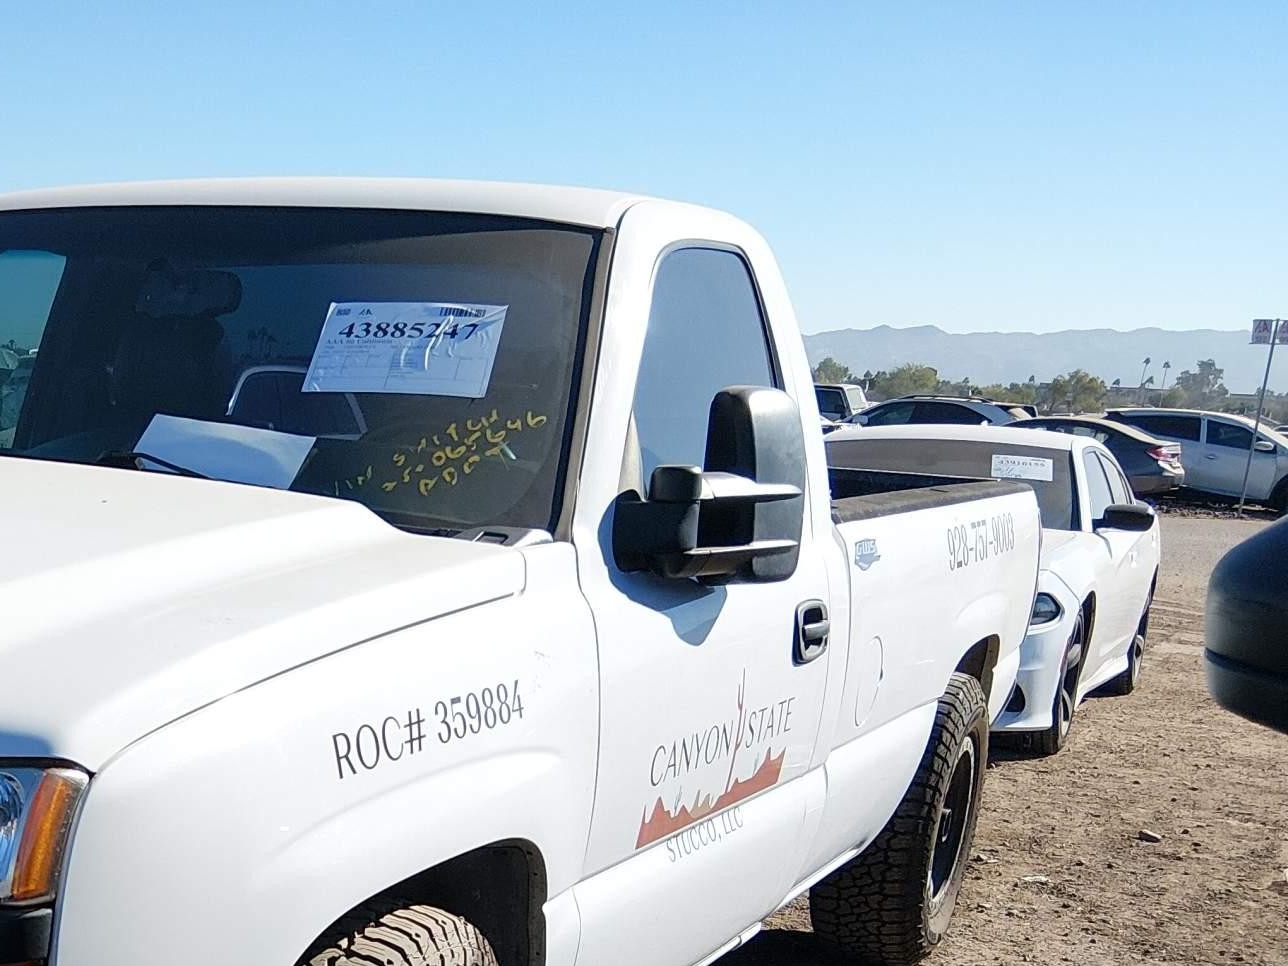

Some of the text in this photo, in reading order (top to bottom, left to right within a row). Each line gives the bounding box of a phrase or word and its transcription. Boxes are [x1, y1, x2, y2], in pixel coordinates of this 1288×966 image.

[339, 322, 479, 340] 43885247
[947, 512, 1015, 571] 928-757-9003
[332, 680, 524, 779] ROC# 359884
[650, 697, 796, 786] CANYON STATE
[665, 806, 744, 863] STUCCO, LLC
